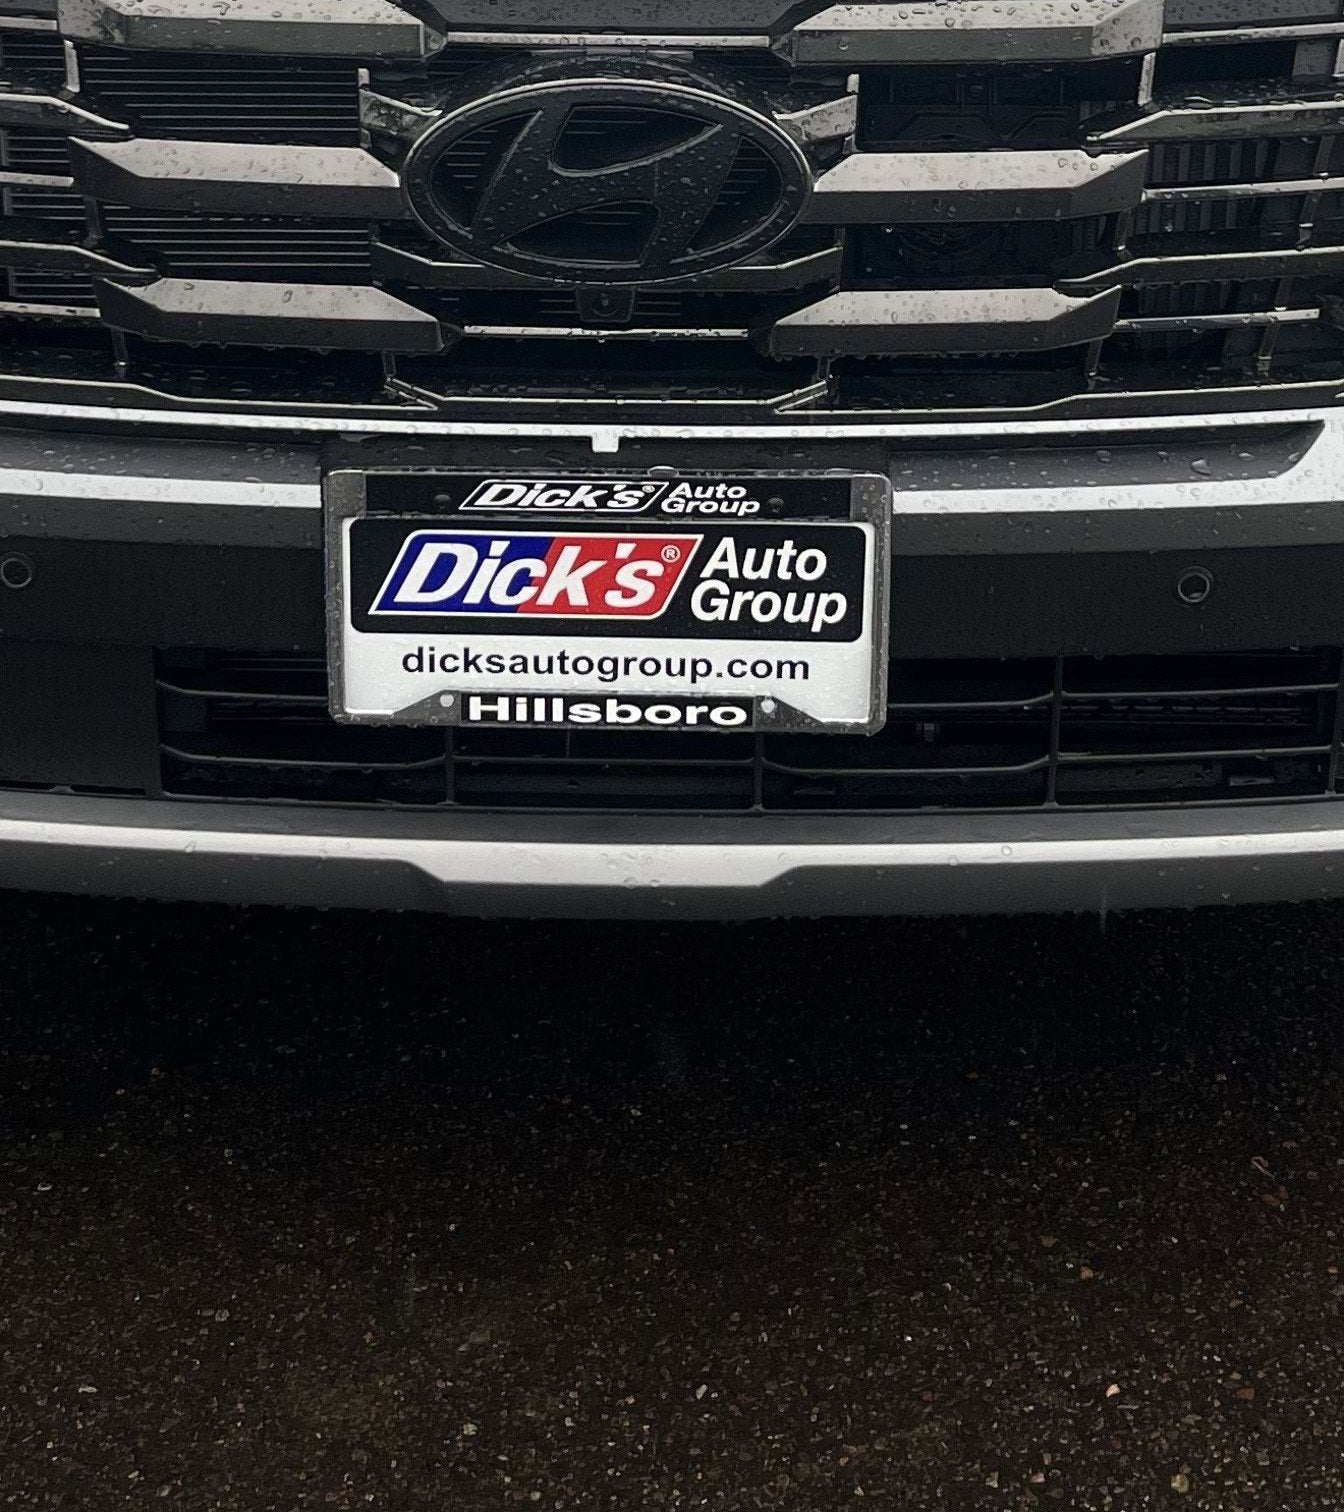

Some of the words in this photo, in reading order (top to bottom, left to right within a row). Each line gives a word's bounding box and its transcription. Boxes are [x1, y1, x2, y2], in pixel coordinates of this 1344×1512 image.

[473, 483, 645, 508] Dick's
[660, 497, 761, 517] Group
[668, 481, 747, 499] Auto
[392, 541, 665, 609] Dick's
[698, 536, 828, 582] Auto
[689, 579, 848, 634] Group
[401, 646, 810, 684] dicksautogroup.com
[468, 695, 749, 727] Hillsboro
